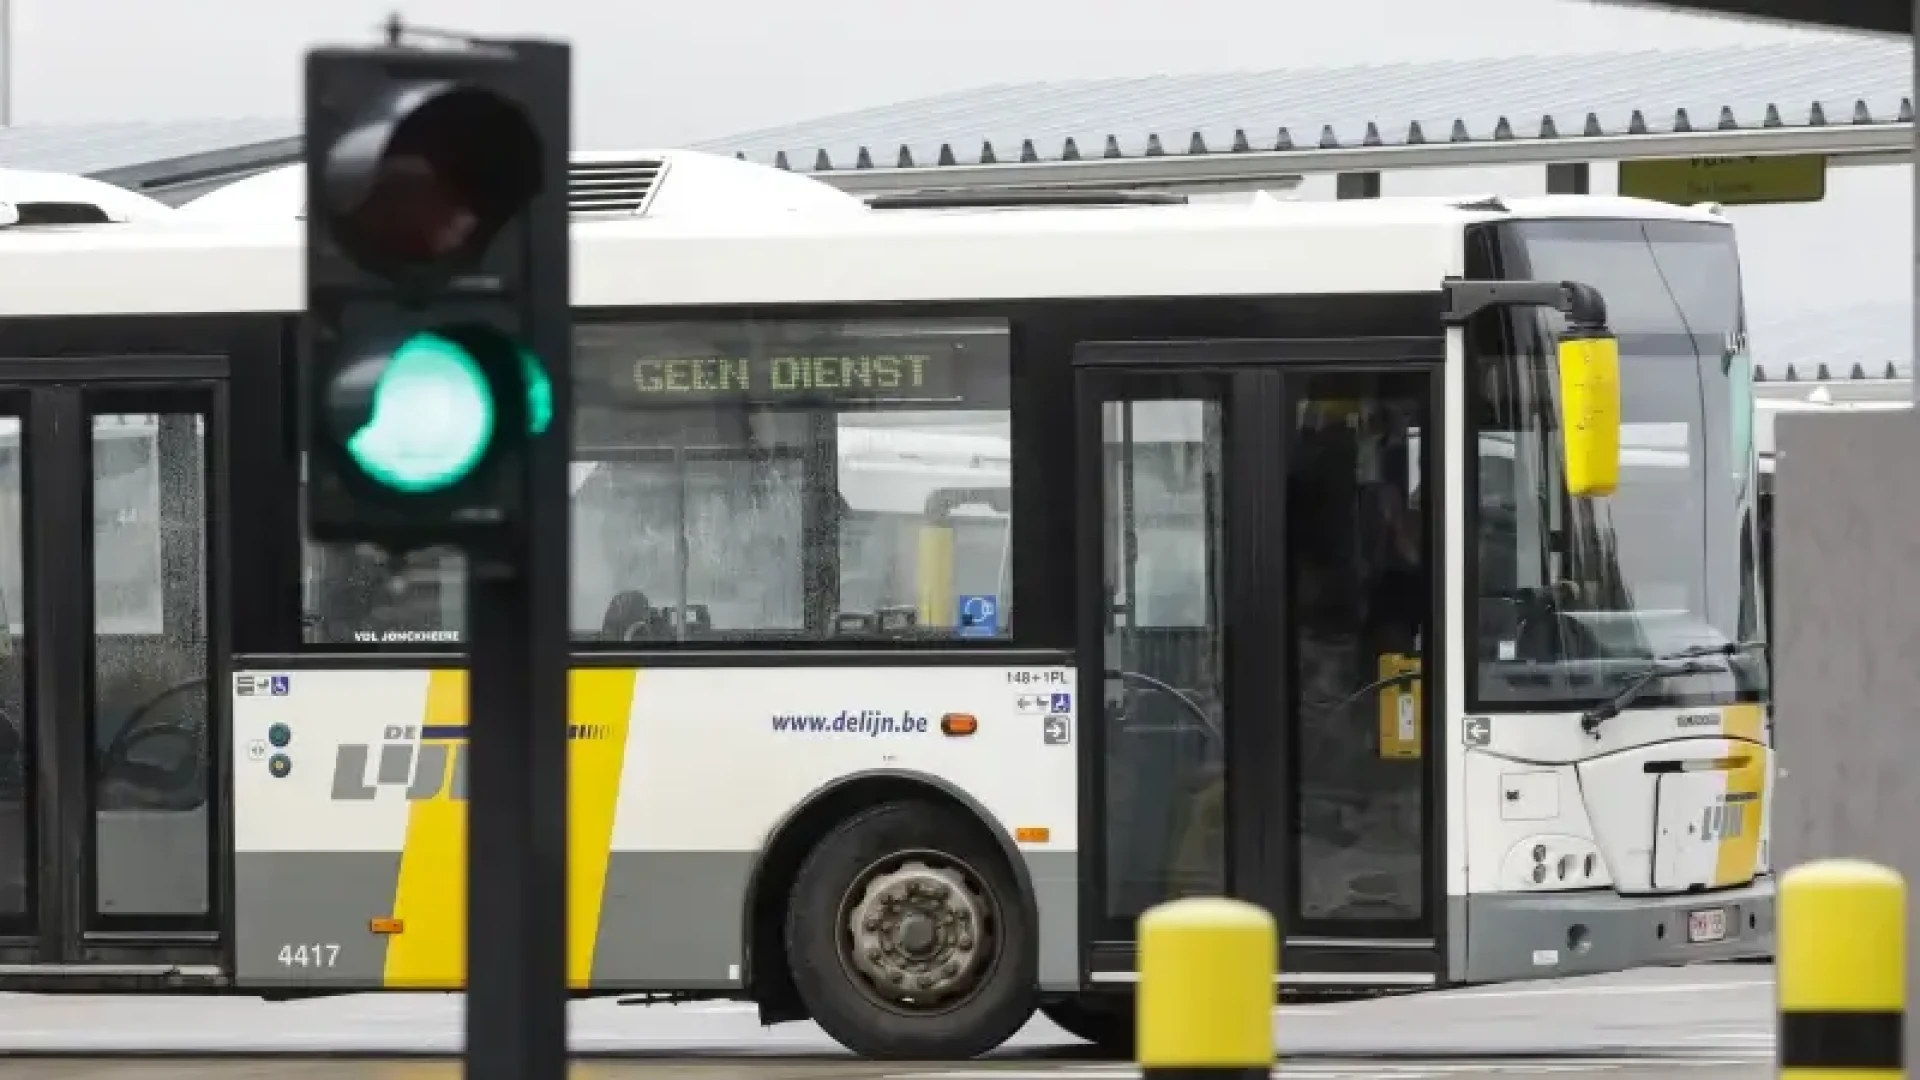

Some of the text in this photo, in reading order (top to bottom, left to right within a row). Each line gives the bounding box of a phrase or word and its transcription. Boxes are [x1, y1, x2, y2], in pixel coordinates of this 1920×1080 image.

[633, 354, 931, 391] GEEN DIENST
[384, 725, 416, 739] DE
[772, 710, 928, 738] www.delijn.be
[331, 743, 469, 800] LIJ
[277, 943, 341, 969] 4417
